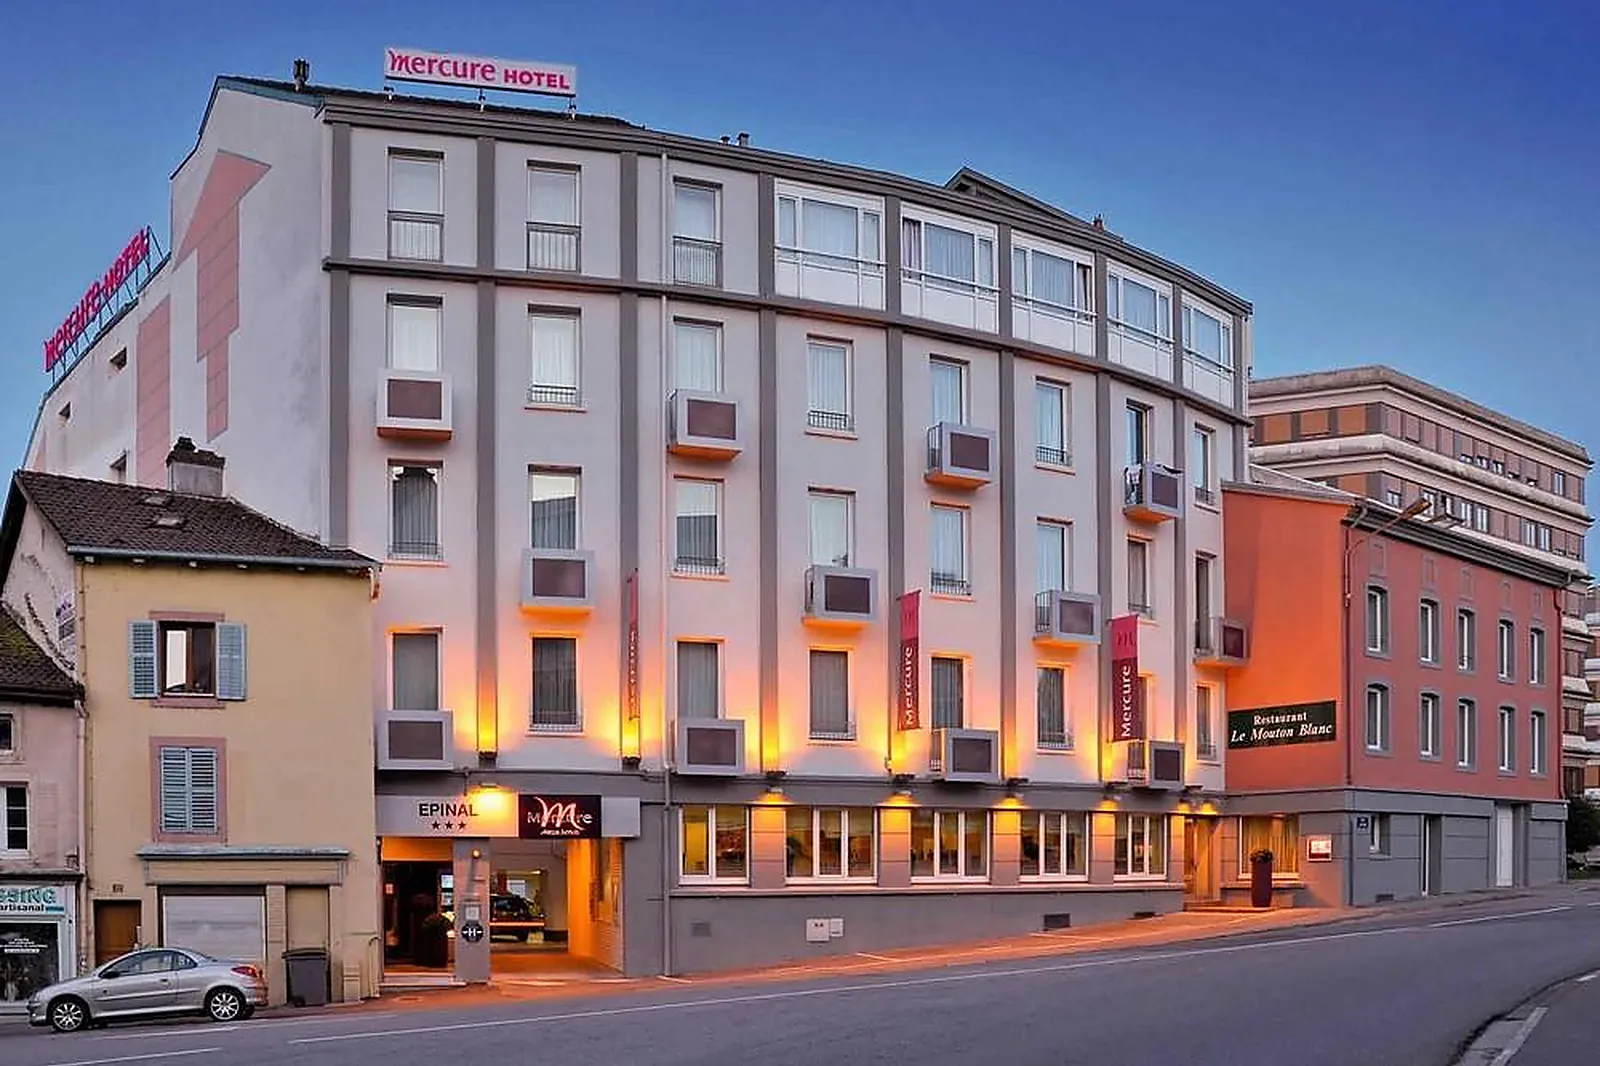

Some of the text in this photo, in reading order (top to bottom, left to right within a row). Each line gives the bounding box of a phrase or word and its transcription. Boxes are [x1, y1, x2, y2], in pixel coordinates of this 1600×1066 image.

[504, 68, 570, 89] HOTEL
[905, 646, 913, 725] Mercure
[1121, 665, 1132, 737] Mercure
[1253, 712, 1307, 726] Restaurant
[1231, 723, 1332, 743] Le Mouton Blanc
[419, 803, 480, 817] EPINAL
